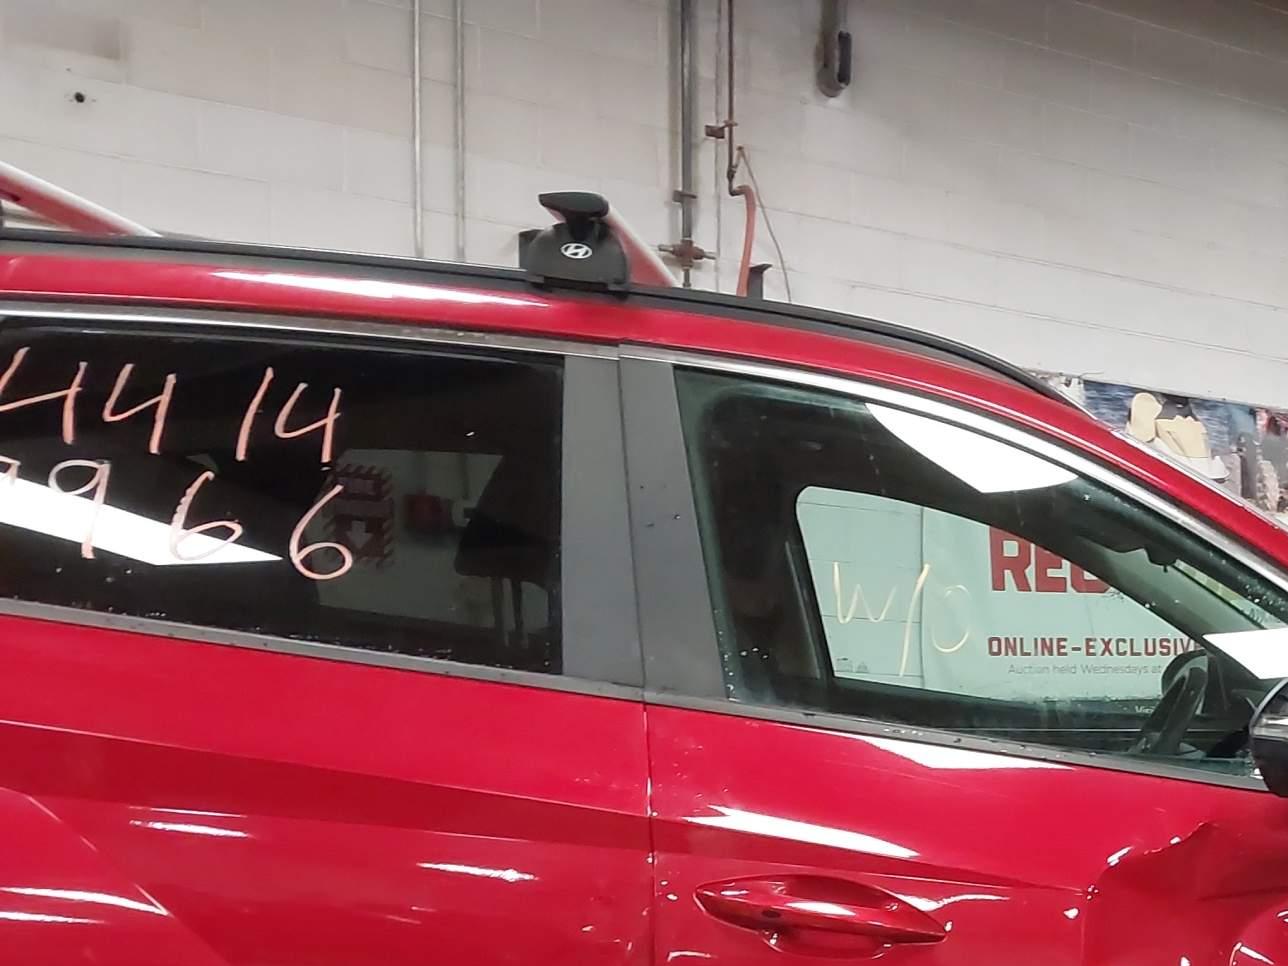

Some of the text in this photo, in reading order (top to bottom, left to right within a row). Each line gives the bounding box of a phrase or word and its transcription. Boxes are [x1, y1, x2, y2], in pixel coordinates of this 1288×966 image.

[1008, 664, 1049, 674] Auction
[1053, 664, 1077, 674] held
[1081, 664, 1149, 677] Wednesdays
